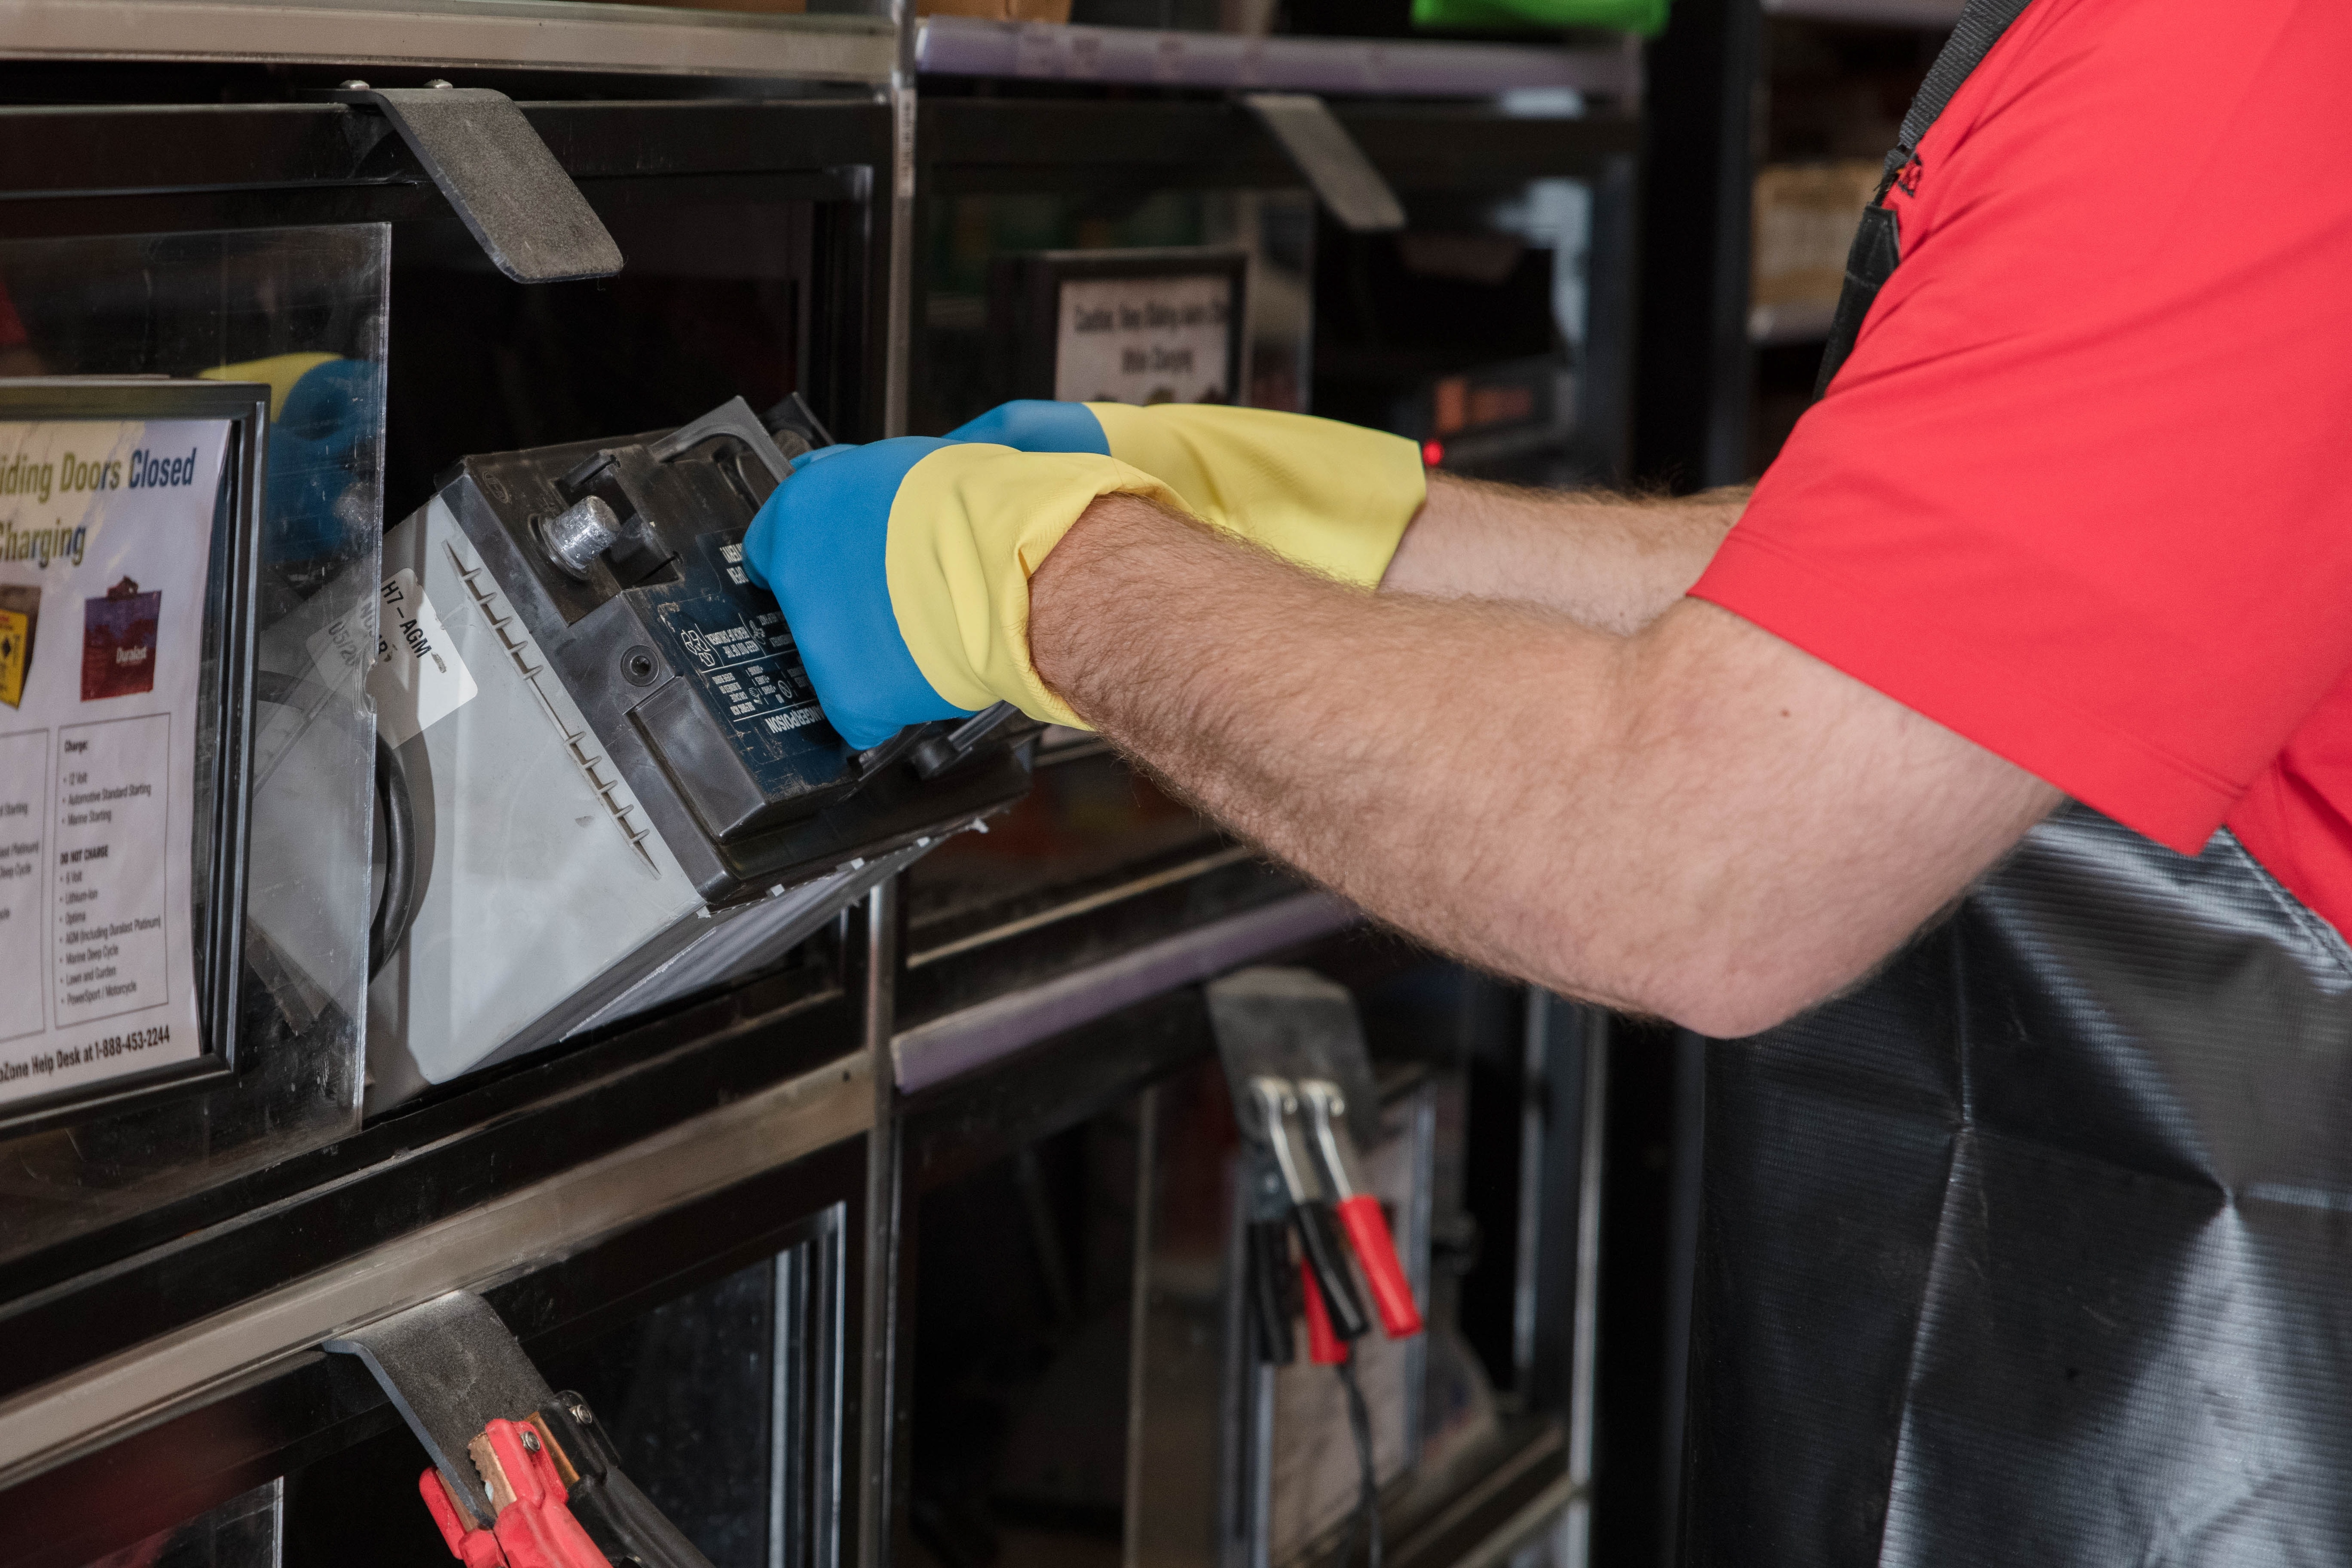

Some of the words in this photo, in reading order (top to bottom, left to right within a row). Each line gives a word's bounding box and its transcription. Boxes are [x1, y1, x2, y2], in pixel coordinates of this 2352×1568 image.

[59, 451, 121, 492] Doors
[128, 447, 197, 489] Closed
[726, 566, 749, 584] OPEN
[704, 631, 731, 646] CHILDREN.
[731, 626, 749, 640] REACH
[722, 646, 735, 657] THE
[736, 642, 749, 654] OUT
[744, 640, 760, 652] KEEP
[70, 849, 82, 863] NOT
[84, 845, 108, 861] CHARGE
[31, 1052, 53, 1076] Help
[56, 1046, 80, 1069] Desk
[83, 1044, 94, 1062] at
